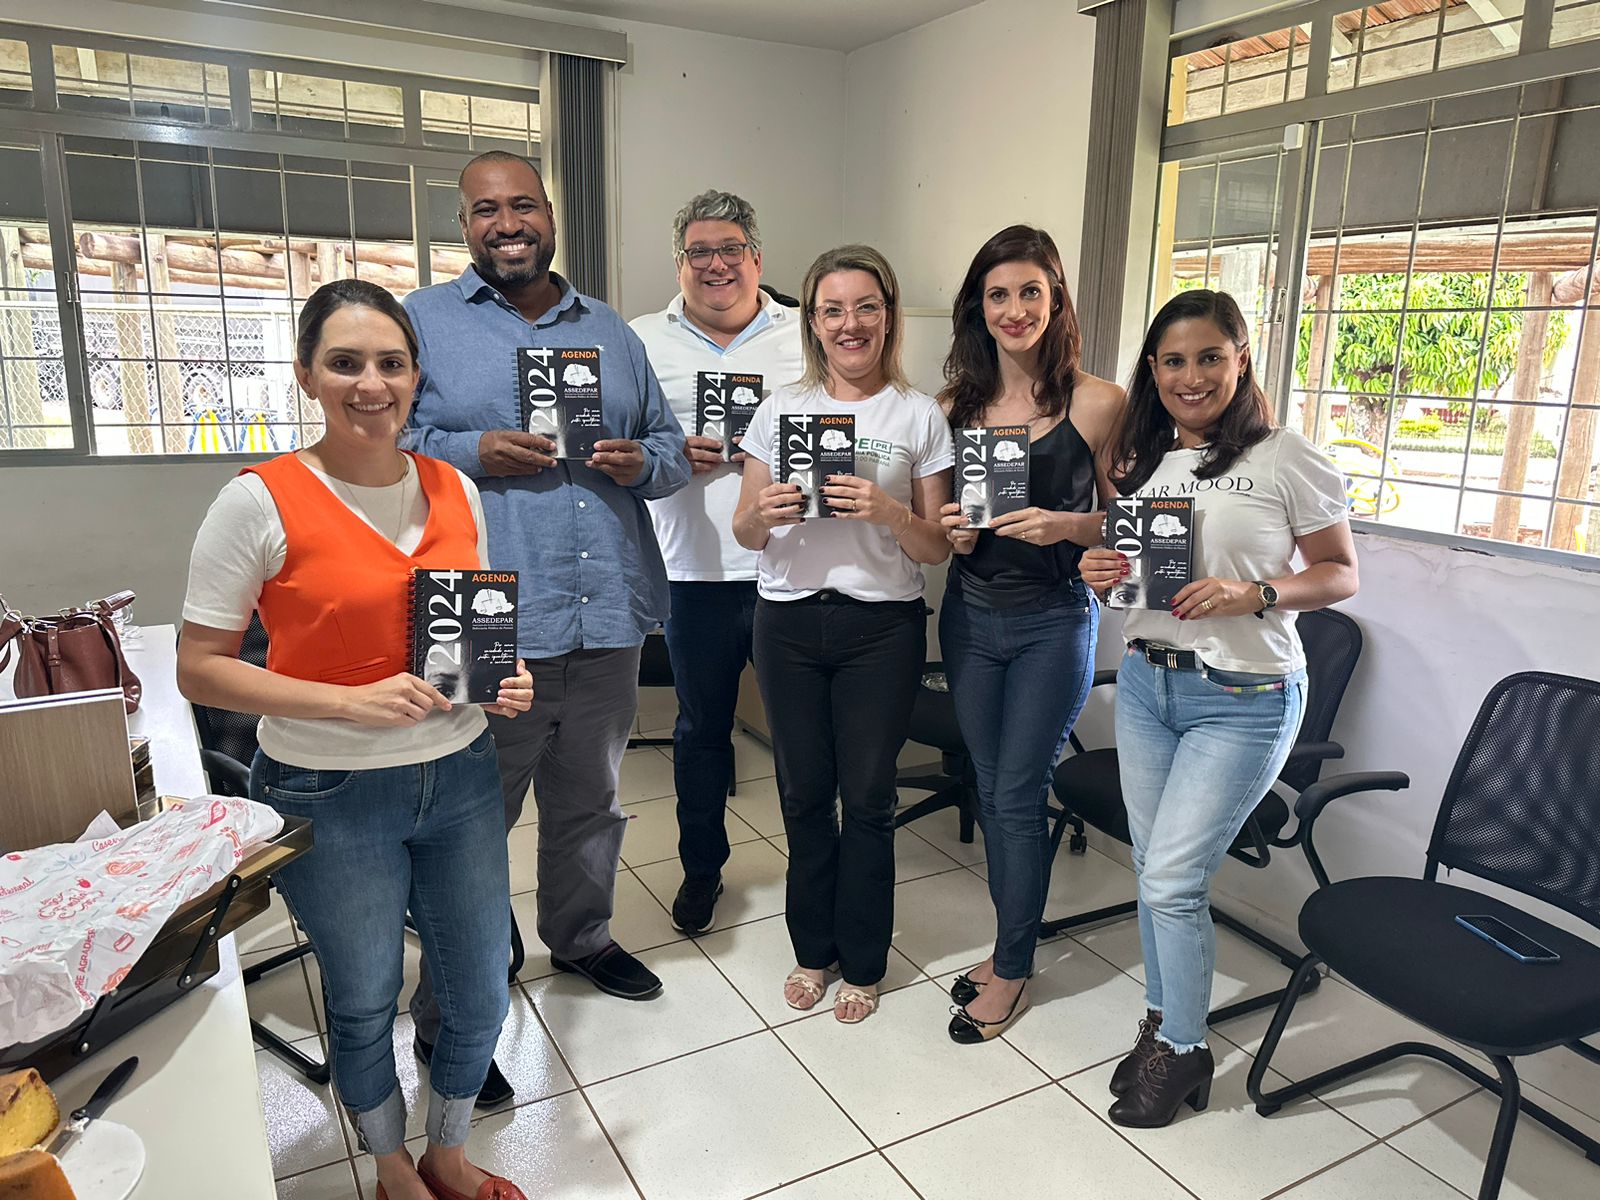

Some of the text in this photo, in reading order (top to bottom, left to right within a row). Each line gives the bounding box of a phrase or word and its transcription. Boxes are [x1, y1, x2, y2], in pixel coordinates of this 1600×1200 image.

[561, 351, 598, 359] AGENDA
[731, 376, 760, 384] AGENDA
[526, 346, 558, 427] 2024
[703, 371, 726, 437] 2024
[819, 417, 853, 425] AGENDA
[992, 428, 1026, 437] AGENDA
[787, 413, 813, 488] 2024
[875, 442, 888, 450] PR
[962, 426, 987, 499] 2024
[1177, 476, 1253, 495] MOOD
[1151, 501, 1190, 509] AGENDA
[471, 573, 516, 583] AGENDA
[427, 569, 463, 666] 2024
